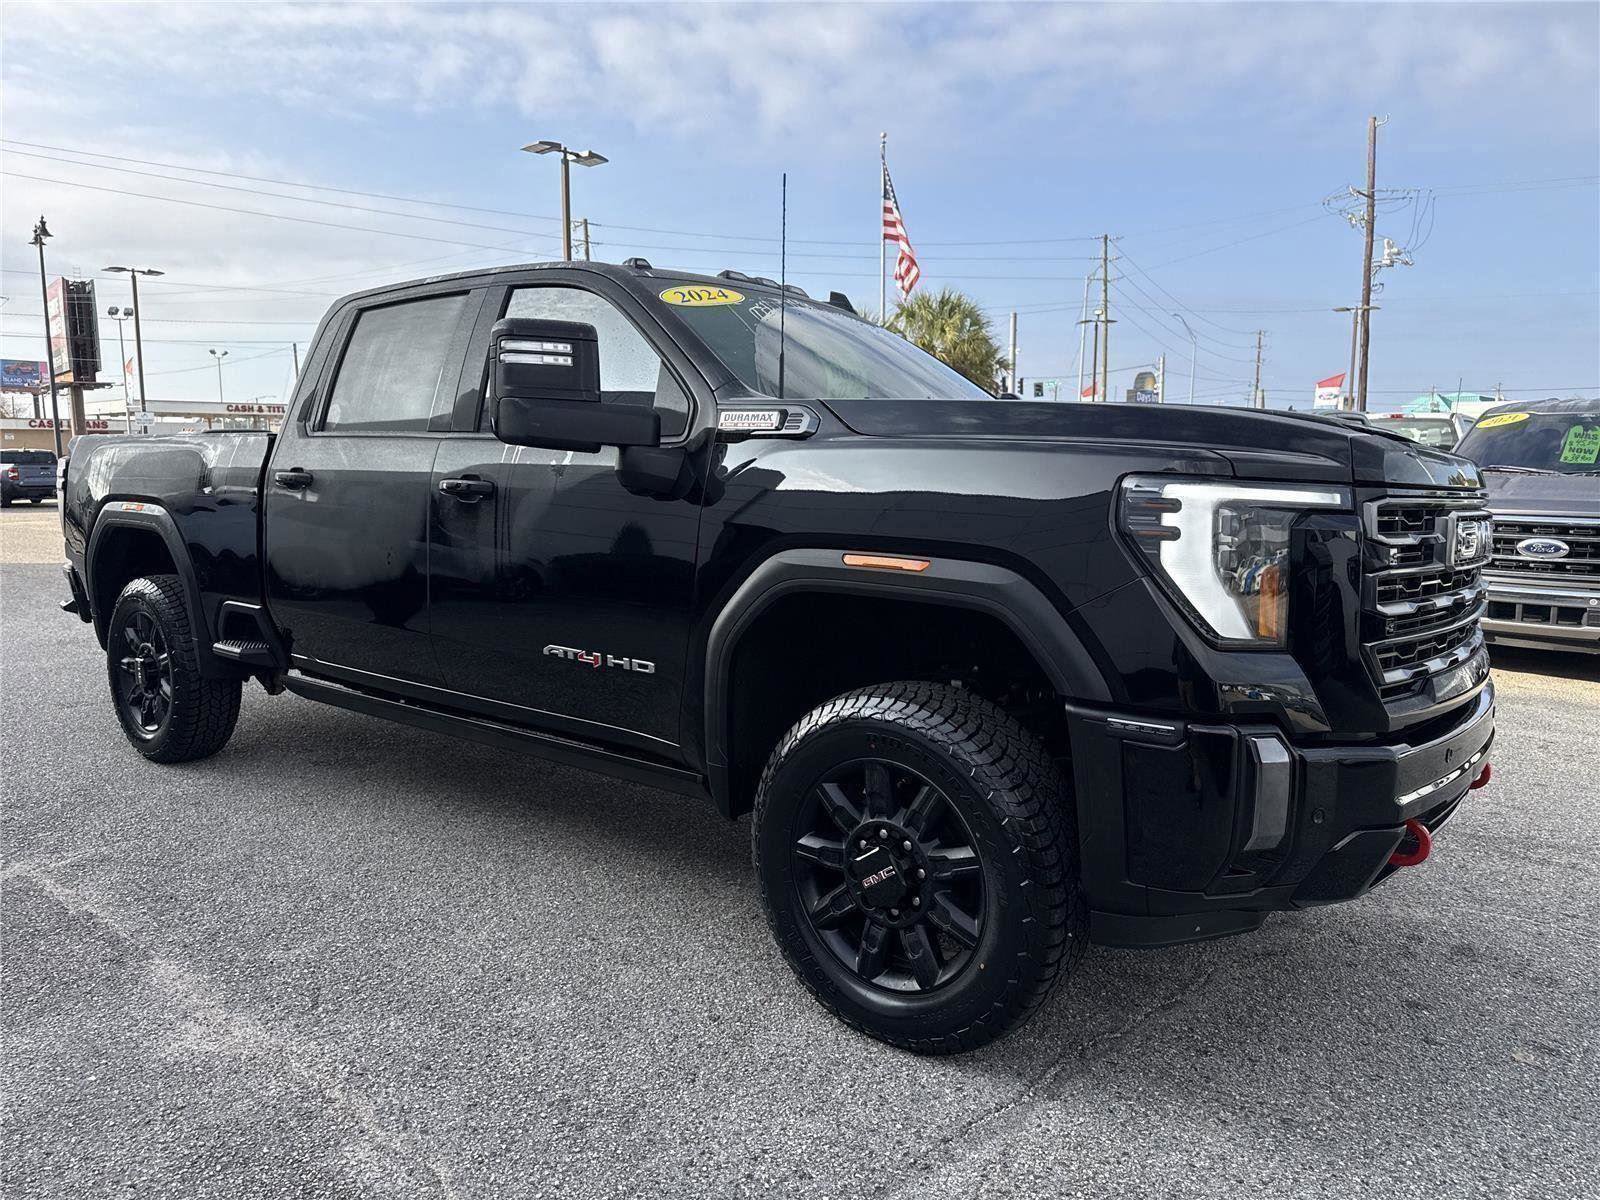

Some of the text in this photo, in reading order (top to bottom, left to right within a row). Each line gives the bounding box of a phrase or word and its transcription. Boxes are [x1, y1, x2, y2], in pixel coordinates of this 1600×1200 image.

[673, 288, 729, 304] 2024
[227, 405, 286, 413] CASH & TITL
[724, 413, 774, 422] DURAMAX
[1568, 446, 1595, 455] NOW
[1530, 543, 1556, 554] Ford
[543, 644, 655, 674] AT4 HD
[862, 865, 896, 889] GMC
